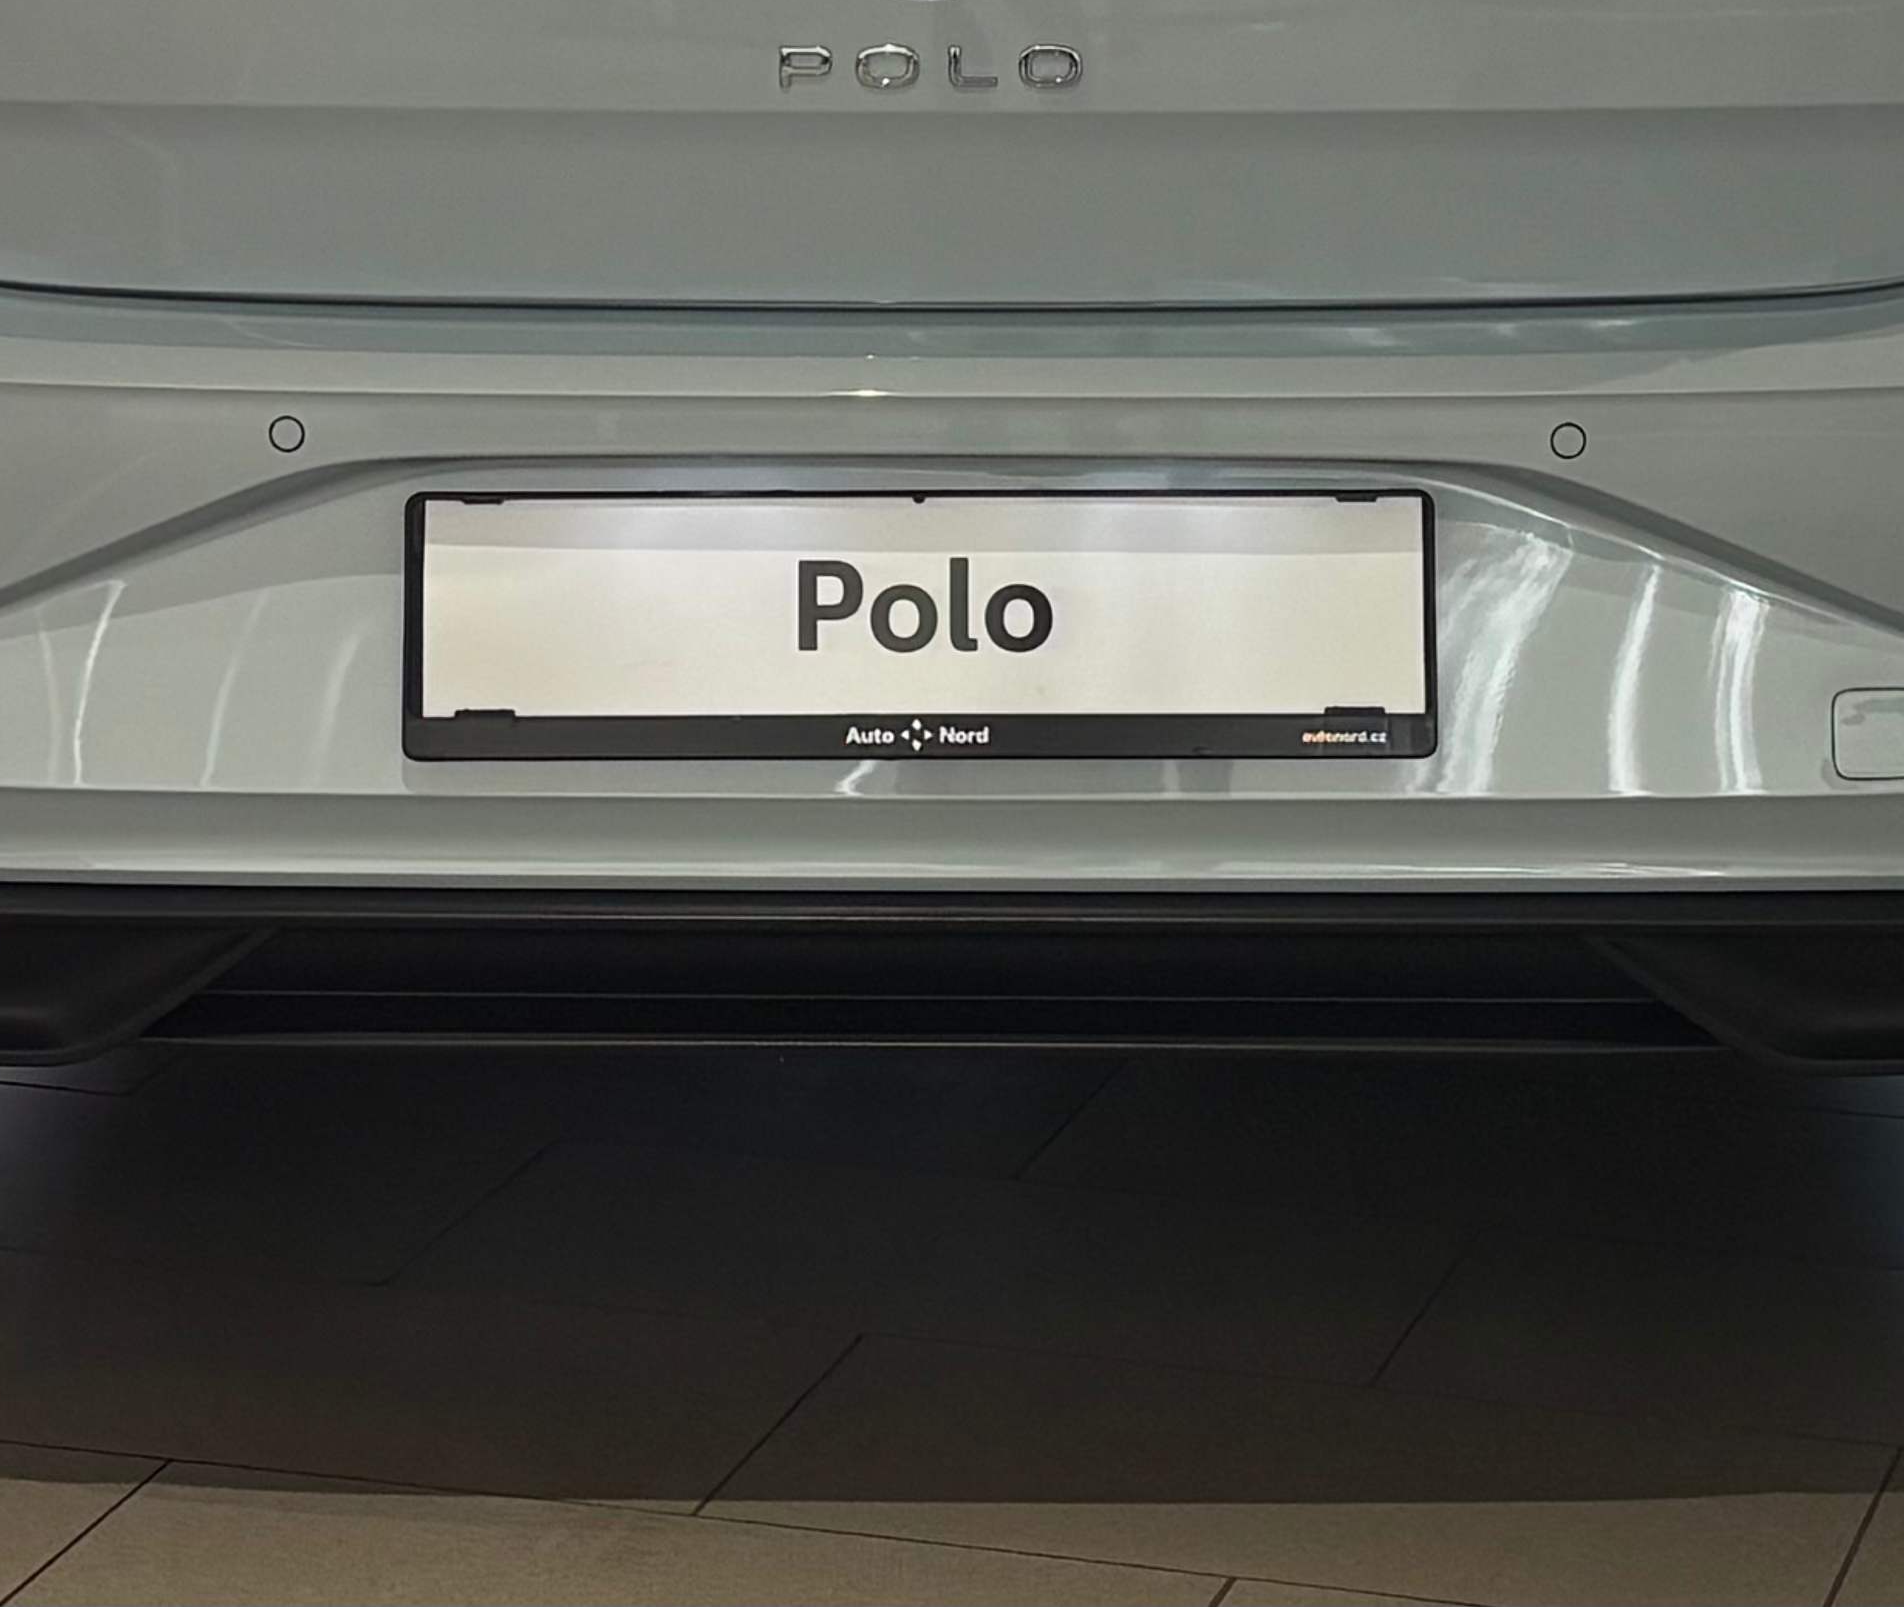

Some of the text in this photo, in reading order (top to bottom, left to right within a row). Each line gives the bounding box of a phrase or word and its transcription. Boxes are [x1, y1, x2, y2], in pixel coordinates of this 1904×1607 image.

[779, 44, 1083, 91] POLO
[798, 557, 1053, 653] Polo
[845, 725, 989, 744] Auto Nord
